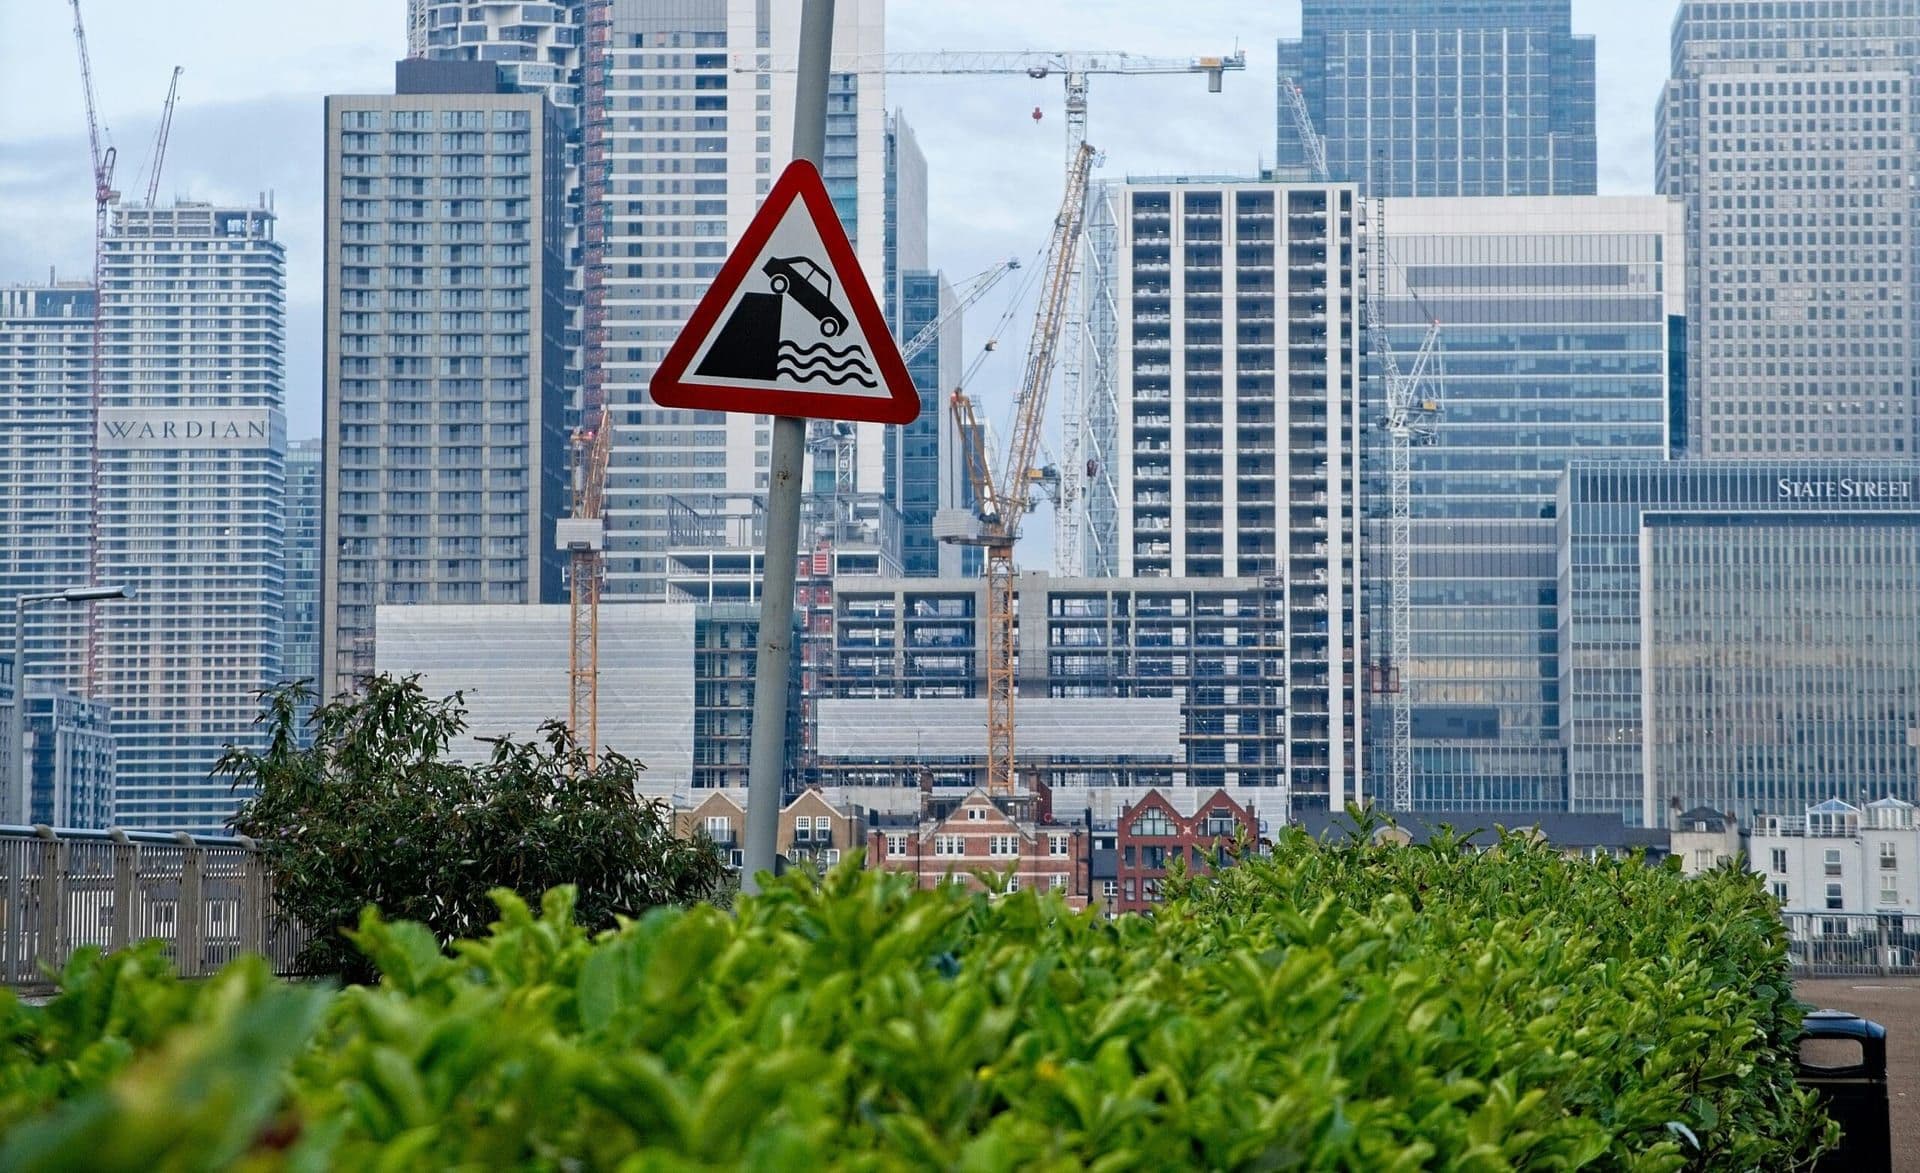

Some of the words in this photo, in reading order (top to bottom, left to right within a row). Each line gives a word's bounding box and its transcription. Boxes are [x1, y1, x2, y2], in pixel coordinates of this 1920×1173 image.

[104, 421, 265, 438] WARDIAN
[1778, 478, 1836, 497] STATE
[1840, 478, 1911, 497] STREET
